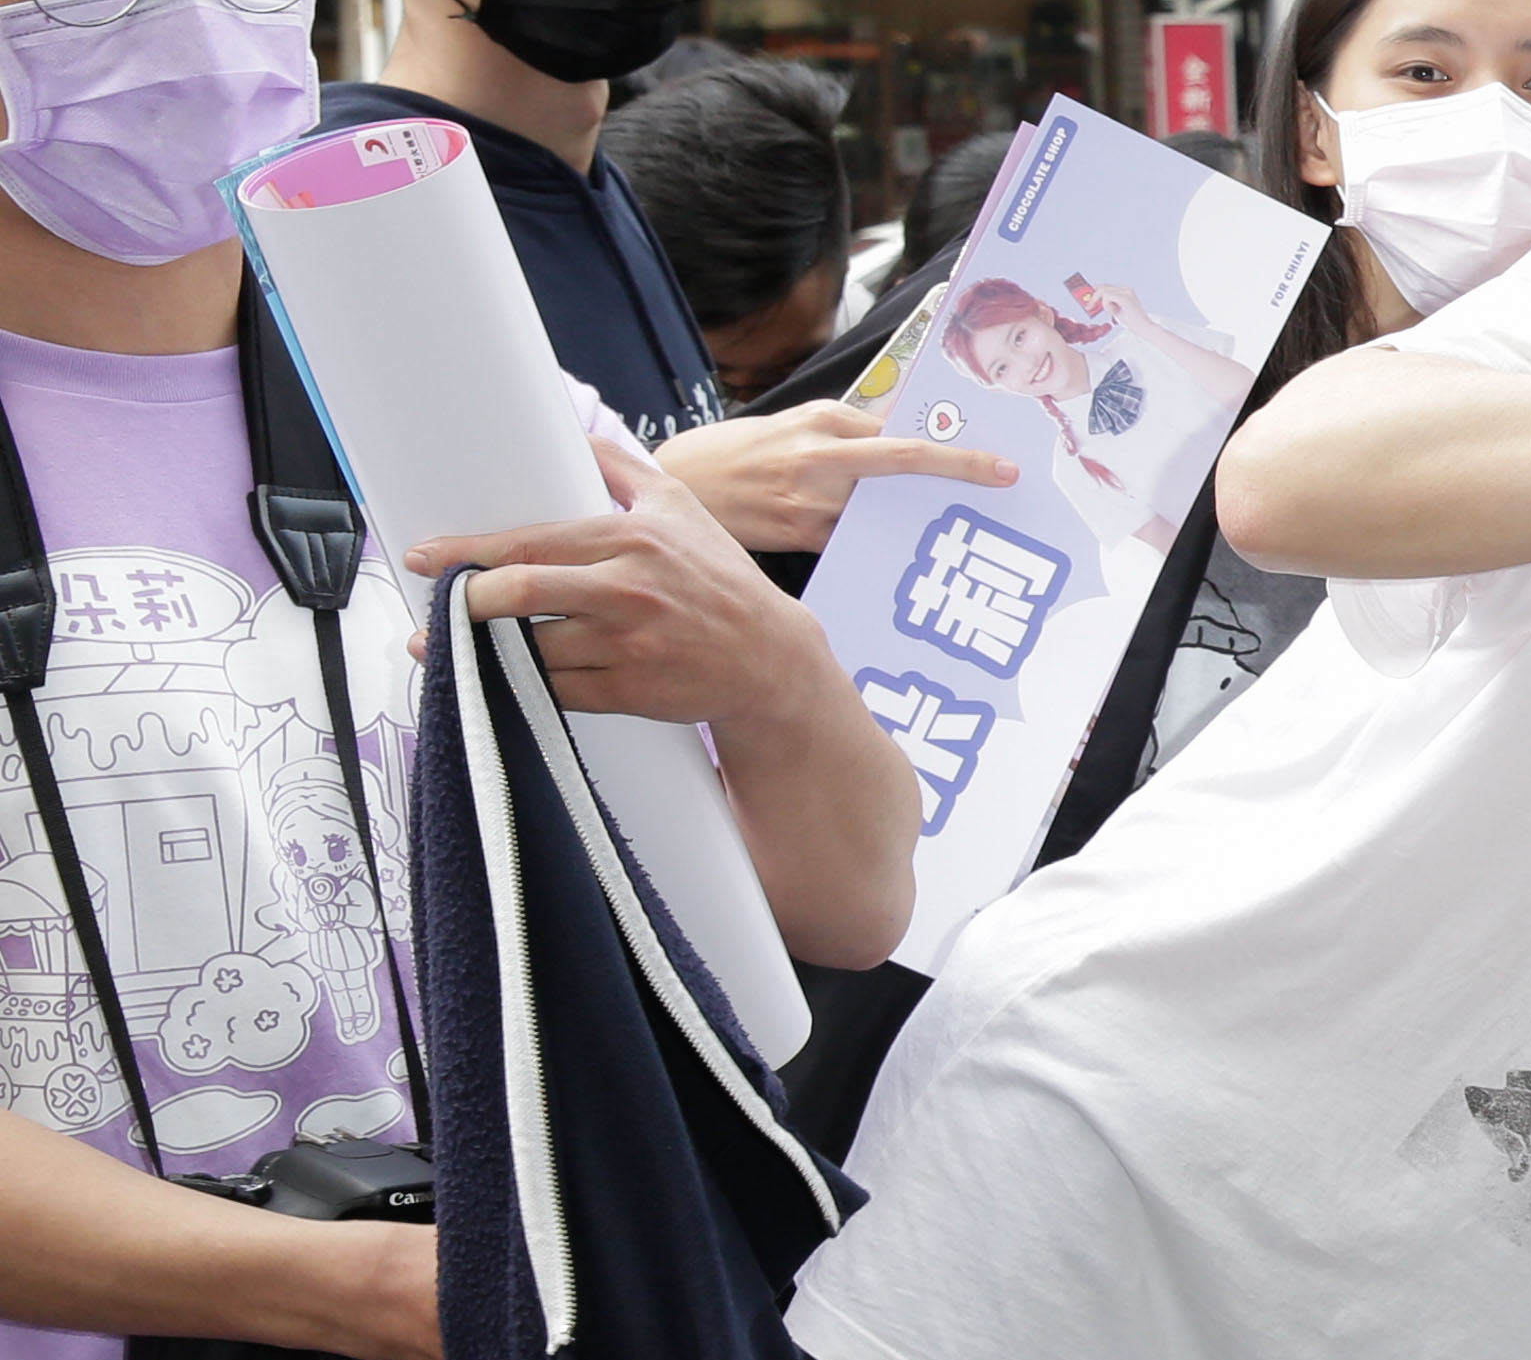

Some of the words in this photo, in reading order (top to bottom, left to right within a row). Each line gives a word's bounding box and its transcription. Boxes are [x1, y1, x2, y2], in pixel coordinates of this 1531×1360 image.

[1007, 161, 1052, 233] CHOCOLATE
[1043, 126, 1069, 163] SHOP
[1270, 282, 1290, 308] FOR
[1283, 240, 1311, 282] CHIAYI
[61, 568, 199, 634] 朵莉
